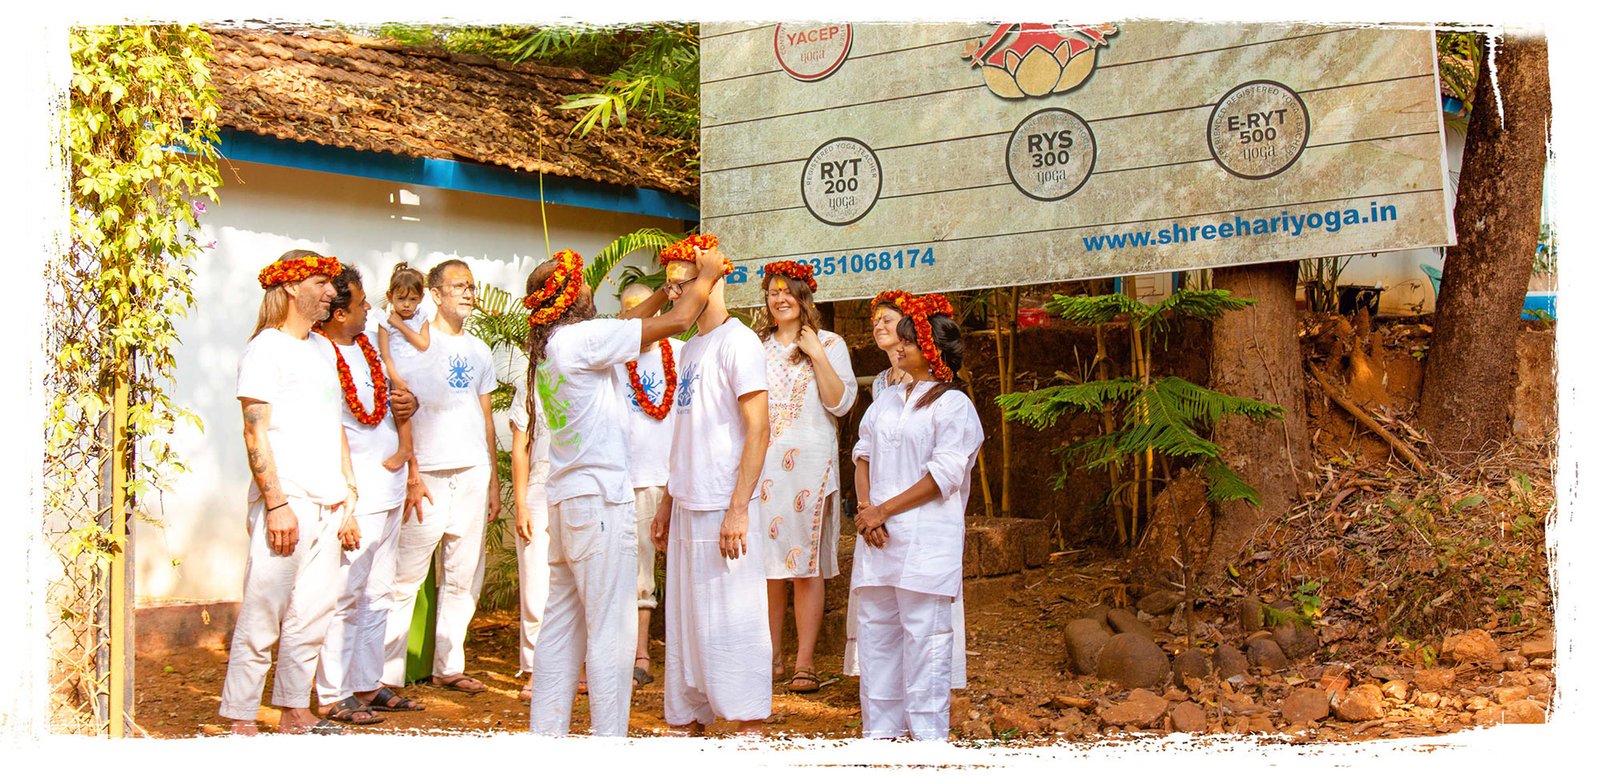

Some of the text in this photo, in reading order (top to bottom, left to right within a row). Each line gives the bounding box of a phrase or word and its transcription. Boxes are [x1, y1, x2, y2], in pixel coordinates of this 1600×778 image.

[786, 25, 839, 46] YACEP
[801, 49, 825, 63] yoga
[1213, 85, 1304, 164] EXPERIENCED REGISTERED YOGA TEACHER
[1227, 108, 1288, 131] E-RYT
[1027, 130, 1073, 153] RYS
[1070, 119, 1090, 149] SCHOOL
[1240, 127, 1276, 144] 500
[1032, 150, 1070, 168] 300
[1243, 145, 1276, 161] yoga
[806, 142, 878, 186] REGISTERED YOGA TEACHER
[820, 158, 862, 179] RYT
[824, 177, 858, 194] 200
[1037, 169, 1067, 184] yoga
[829, 195, 855, 209] yoga
[1082, 201, 1397, 251] www.shreehariyoga.in
